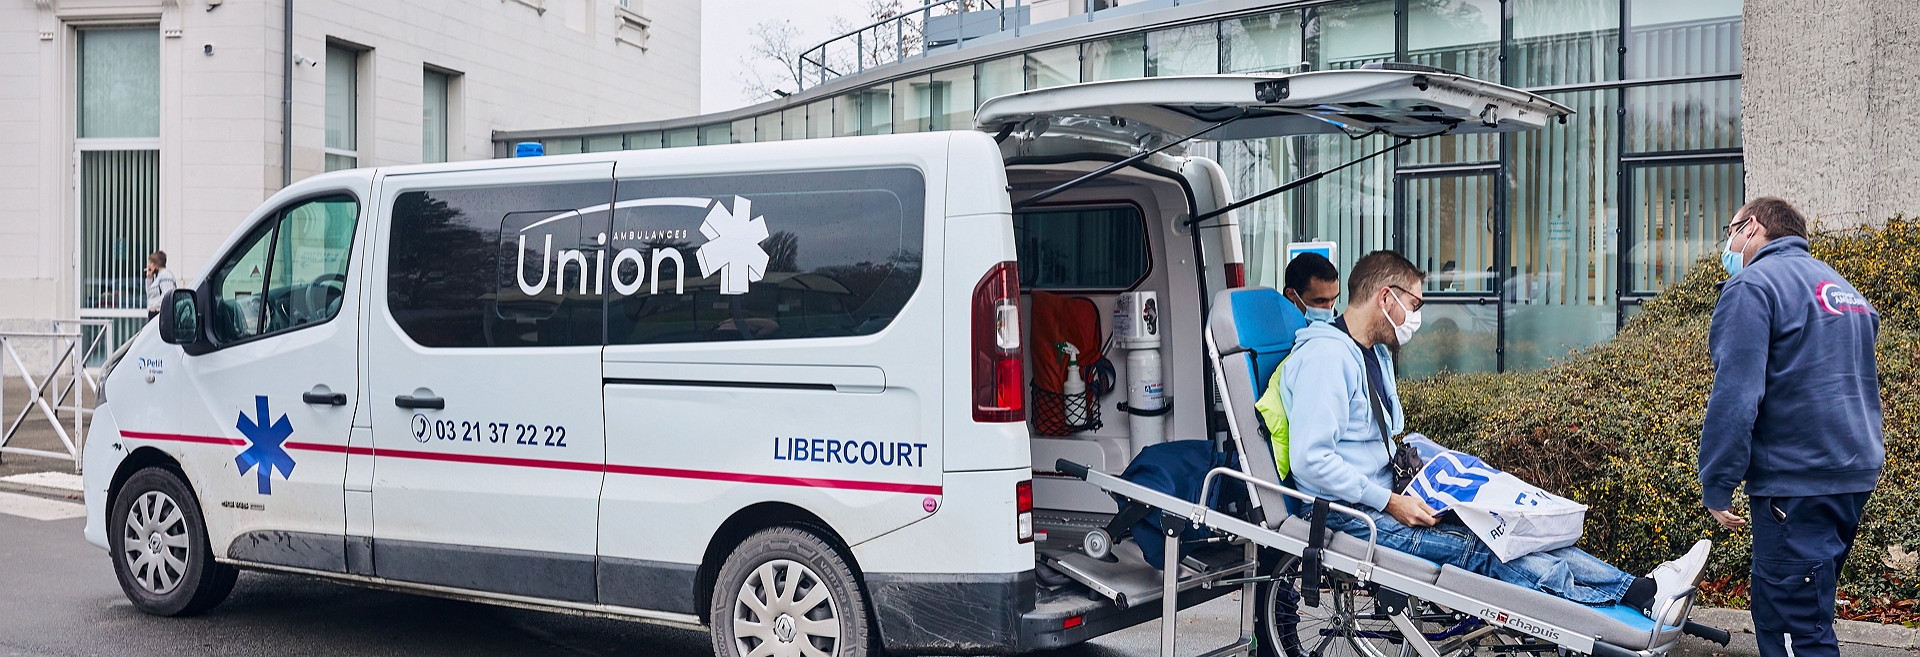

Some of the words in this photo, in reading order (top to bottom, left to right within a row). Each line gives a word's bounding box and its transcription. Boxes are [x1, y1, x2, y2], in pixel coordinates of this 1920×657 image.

[613, 229, 687, 241] AMBULANCES
[517, 232, 685, 296] Union
[147, 358, 163, 368] Petit
[435, 419, 457, 441] 03
[461, 420, 481, 442] 21
[488, 422, 509, 444] 37
[515, 423, 538, 446] 22
[543, 425, 567, 448] 22
[773, 436, 928, 468] LIBERCOURT
[1480, 608, 1497, 619] rts
[1508, 618, 1560, 640] chapuis
